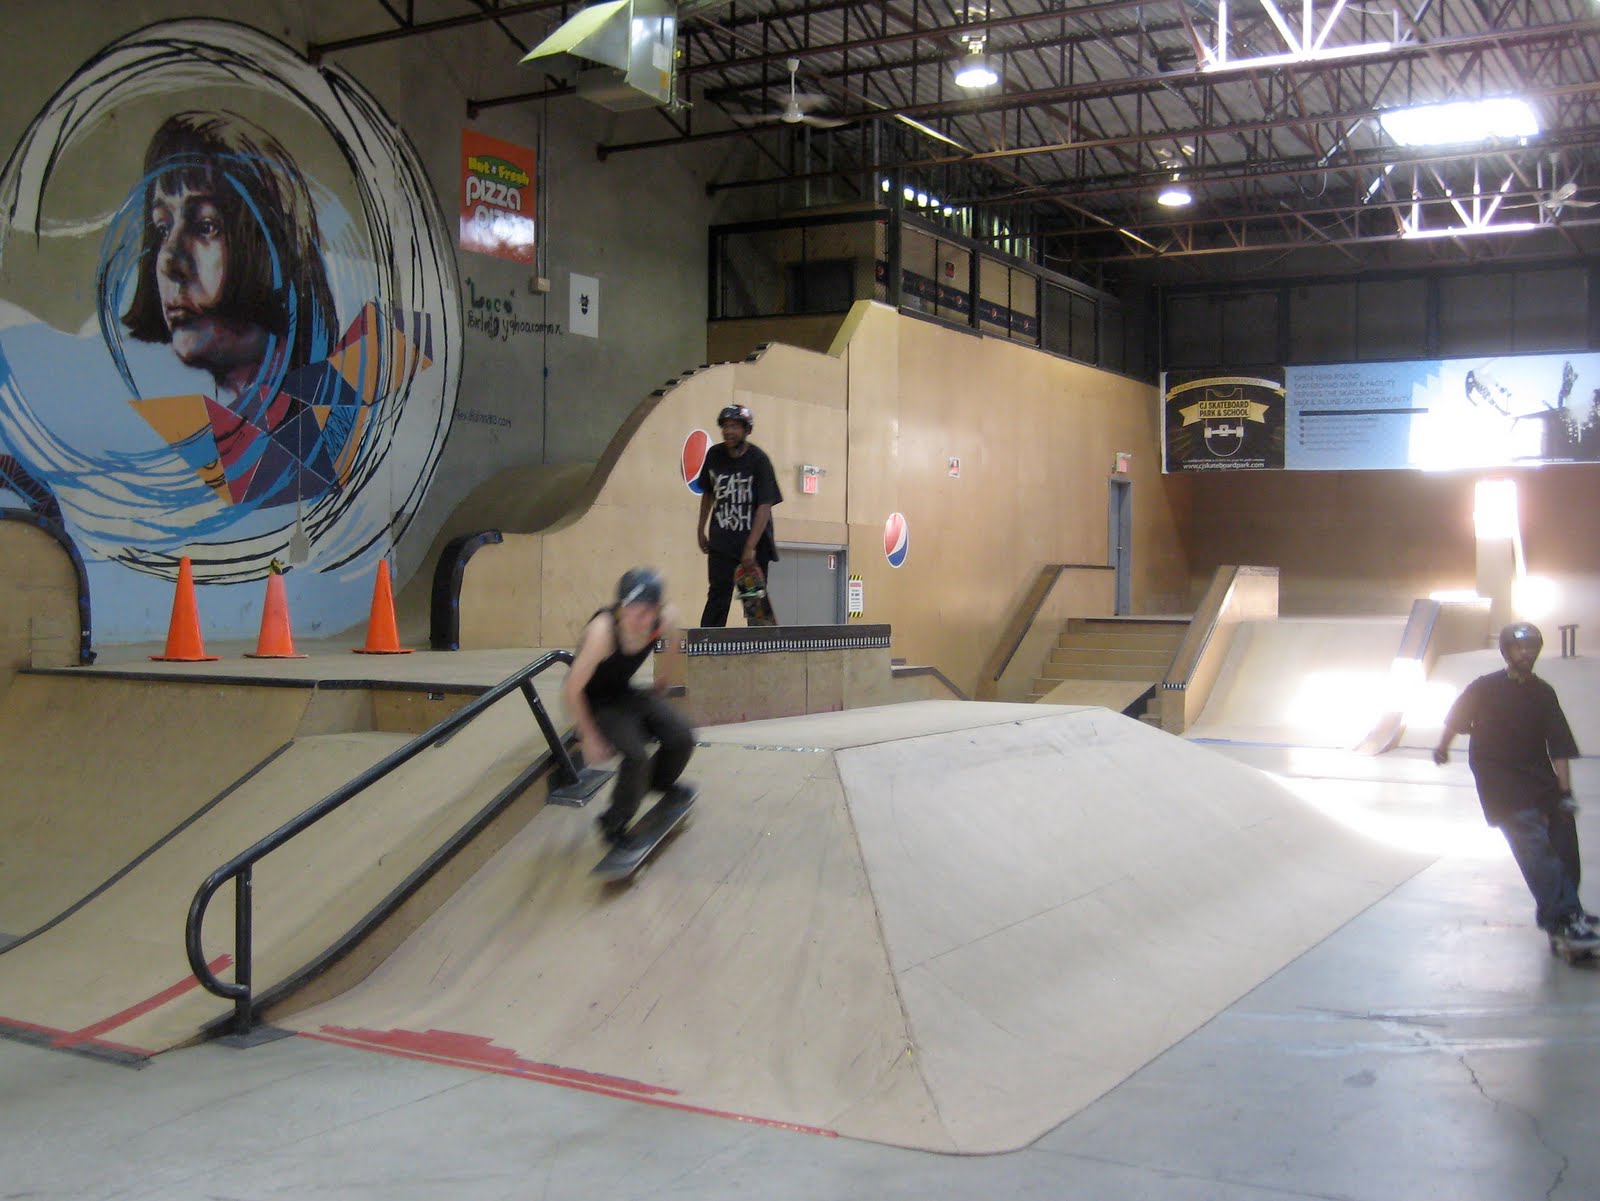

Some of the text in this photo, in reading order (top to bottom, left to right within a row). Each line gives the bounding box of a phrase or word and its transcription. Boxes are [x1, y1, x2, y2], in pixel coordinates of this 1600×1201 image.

[468, 157, 490, 174] Hot
[498, 165, 529, 186] Fresh
[1200, 401, 1249, 409] CJ SKATEBOARD
[1217, 409, 1222, 417] &
[1223, 409, 1249, 417] SCHOOL
[1183, 462, 1265, 470] www.cjskateboardpark.com
